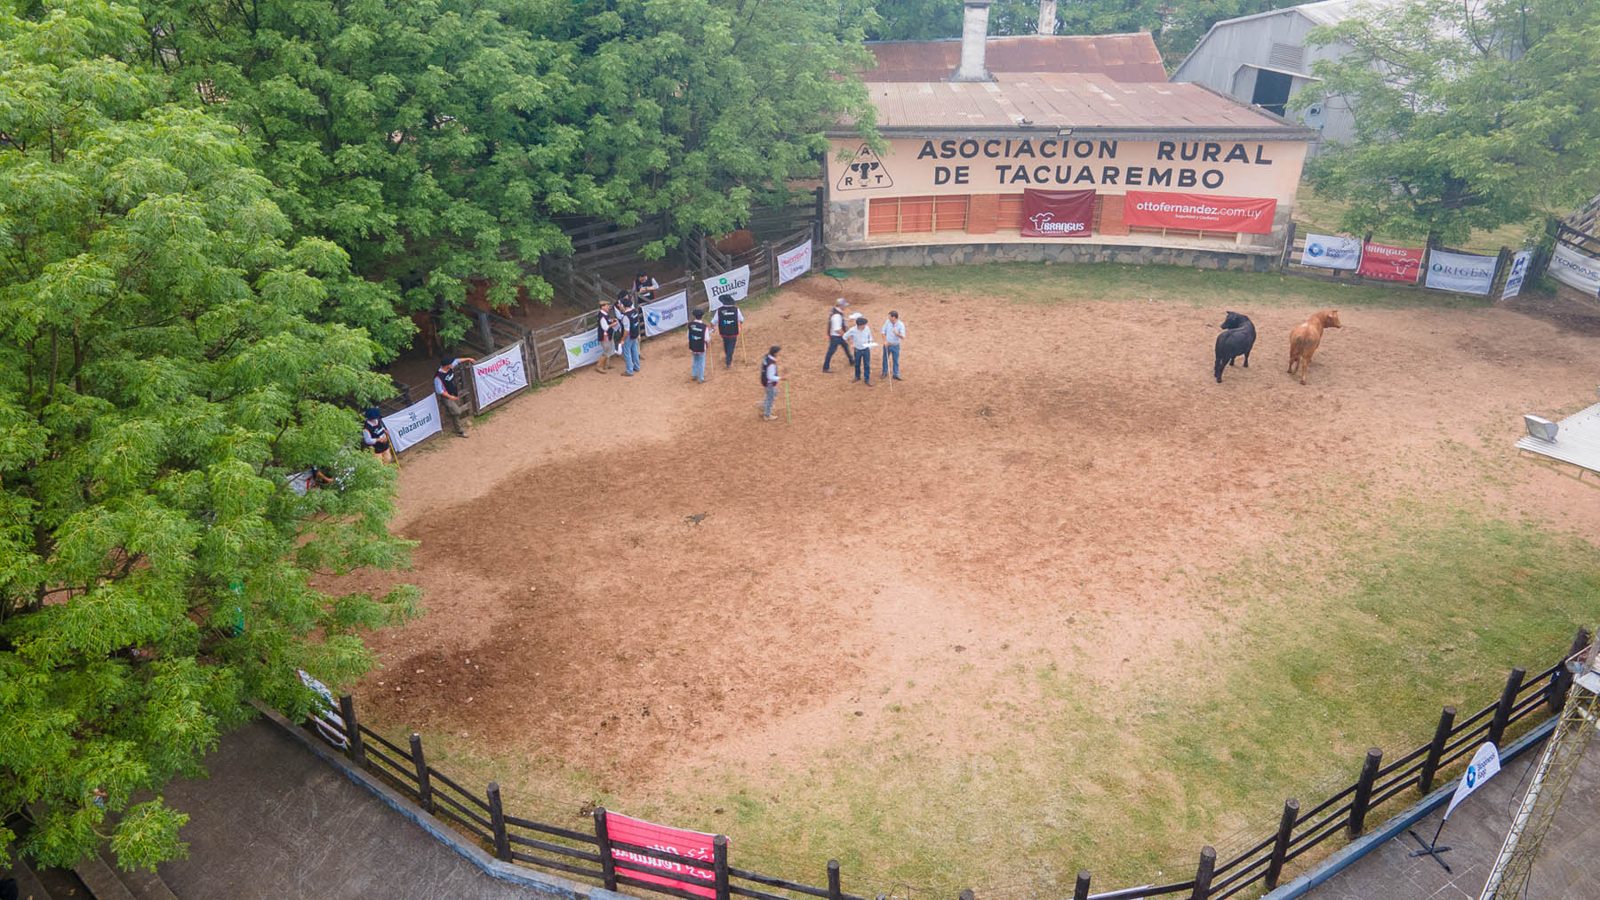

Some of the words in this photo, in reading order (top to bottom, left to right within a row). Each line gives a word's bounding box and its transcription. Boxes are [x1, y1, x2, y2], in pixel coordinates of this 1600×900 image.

[860, 147, 870, 156] A
[917, 139, 1118, 160] ASOCIACION
[1157, 141, 1273, 165] RURAL
[844, 176, 853, 186] R
[875, 174, 884, 184] T
[934, 166, 970, 185] DE
[995, 165, 1224, 189] TACUAREMBO
[1136, 201, 1262, 220] ottofernandez.com.uy
[1044, 222, 1085, 233] BRANGUS
[1432, 263, 1491, 278] ORIGEN
[711, 279, 746, 297] Rurales
[398, 413, 432, 438] plazarural
